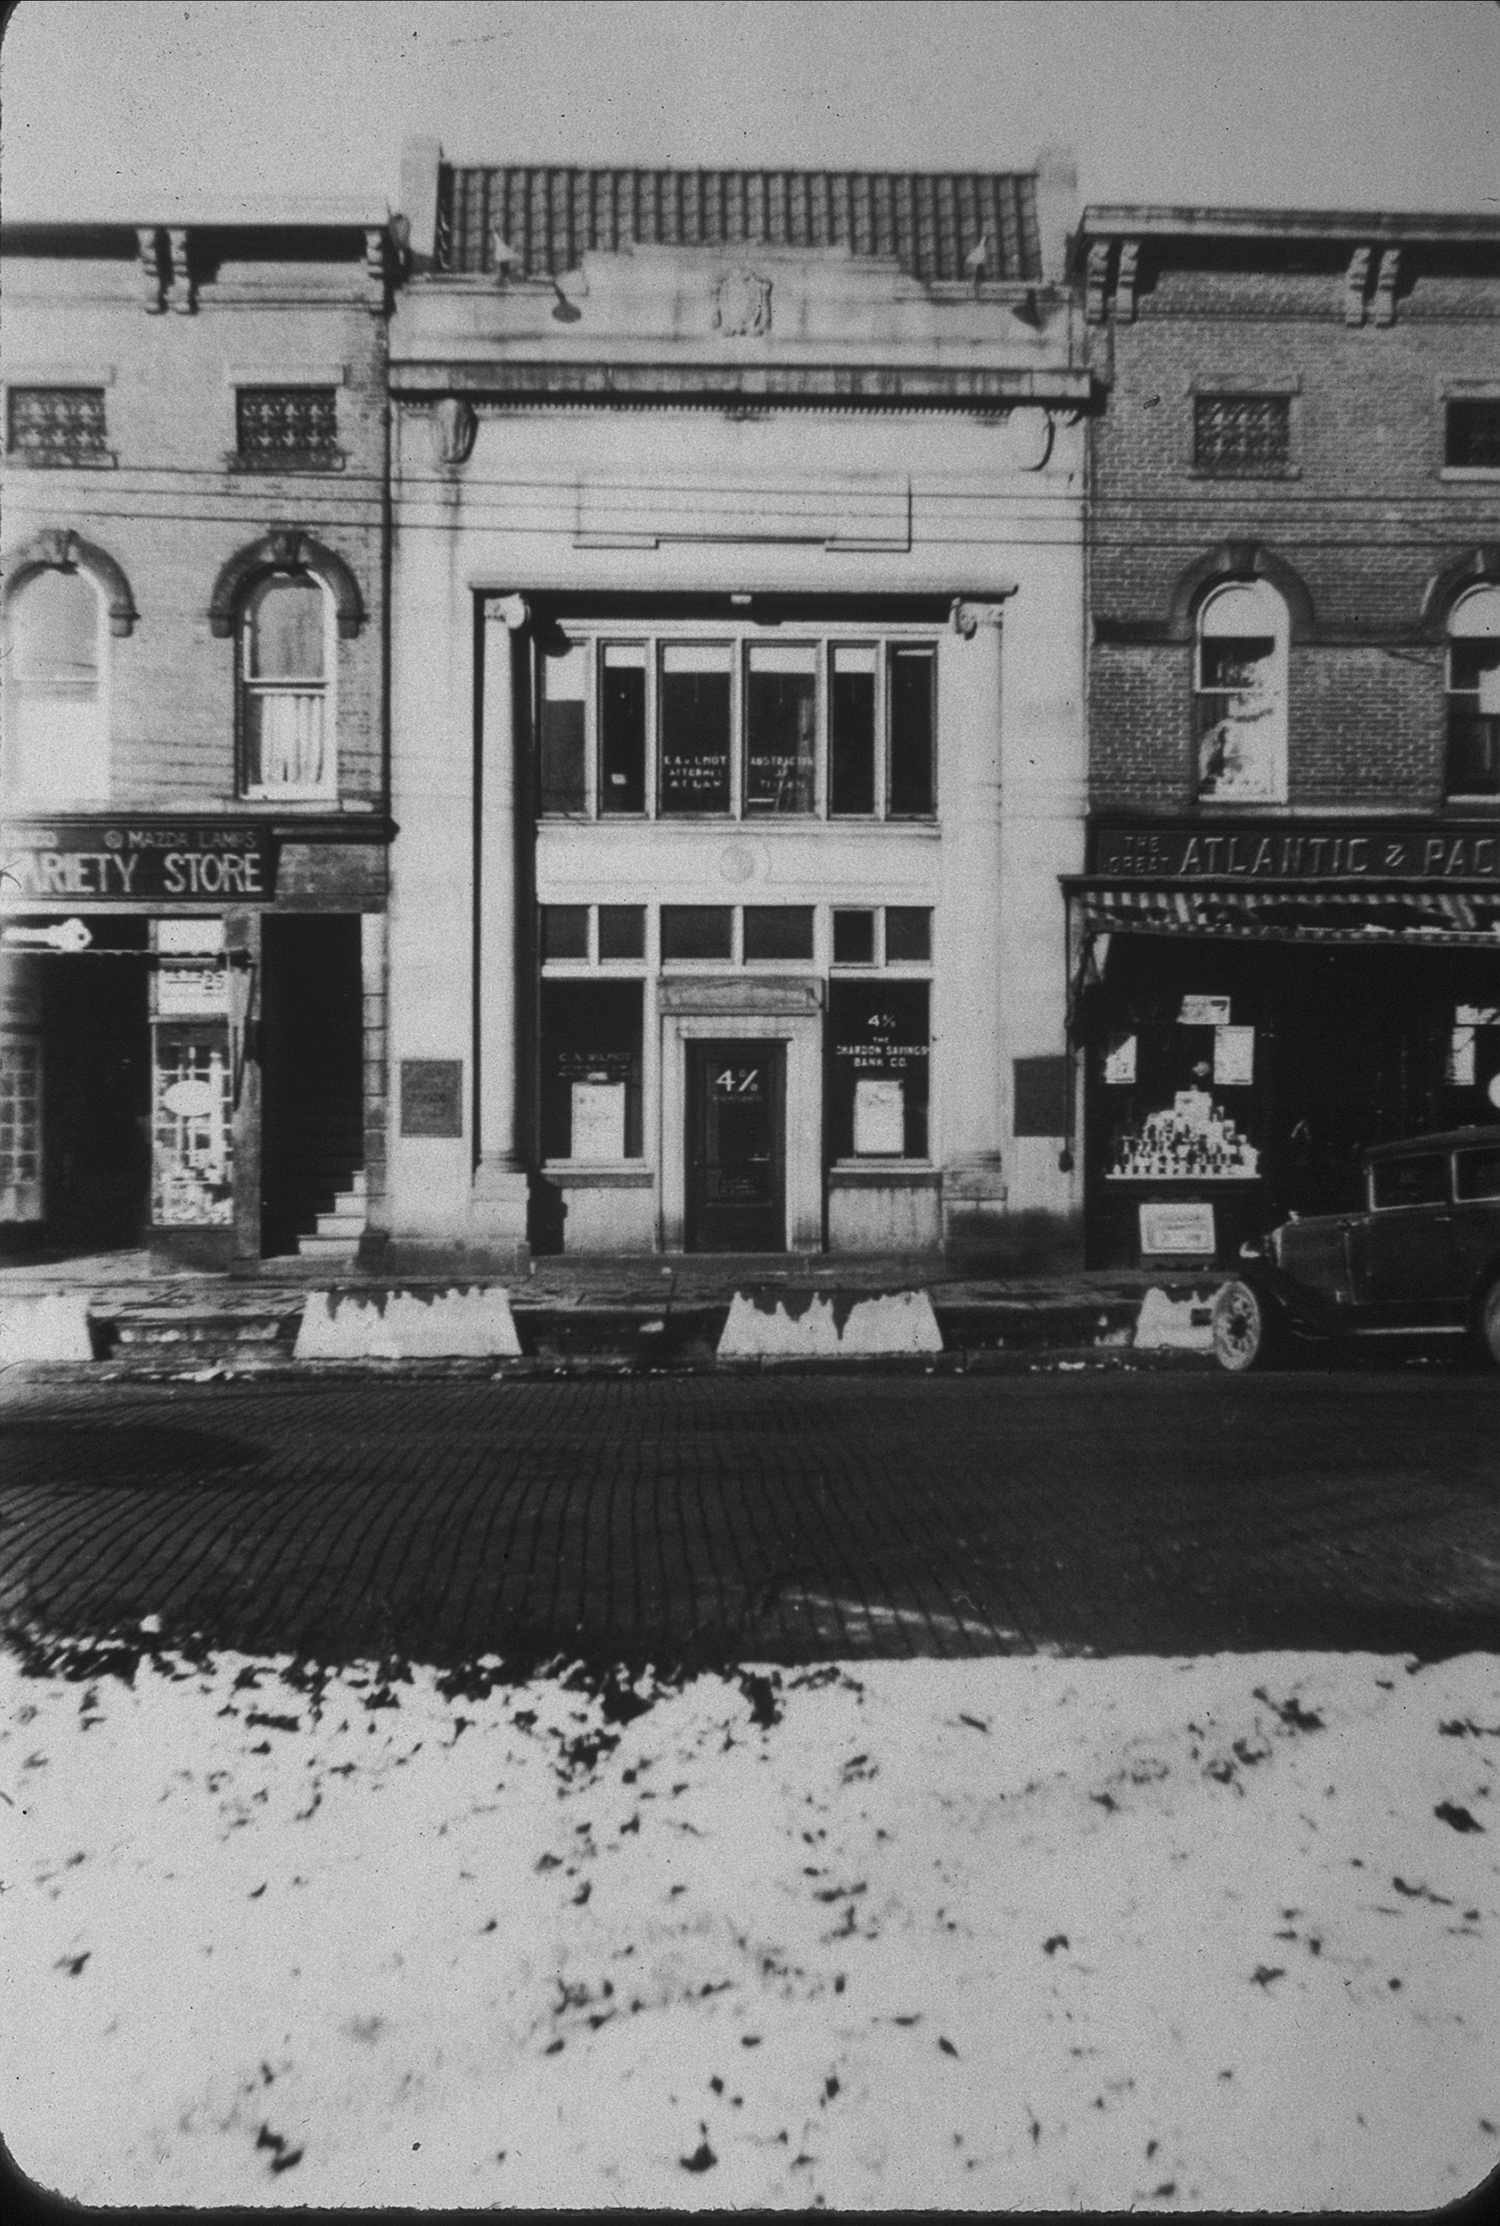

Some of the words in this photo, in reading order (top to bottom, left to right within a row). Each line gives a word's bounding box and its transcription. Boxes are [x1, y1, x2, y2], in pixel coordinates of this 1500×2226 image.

[128, 830, 187, 848] MAZDA
[1124, 836, 1160, 852] THE
[1178, 836, 1370, 875] ATLANTIC
[1423, 838, 1496, 875] PAC
[163, 852, 263, 893] STORE
[867, 1014, 896, 1028] 4%
[886, 1045, 928, 1056] SAVINGS
[854, 1057, 884, 1068] BANK
[715, 1068, 759, 1092] 4%
